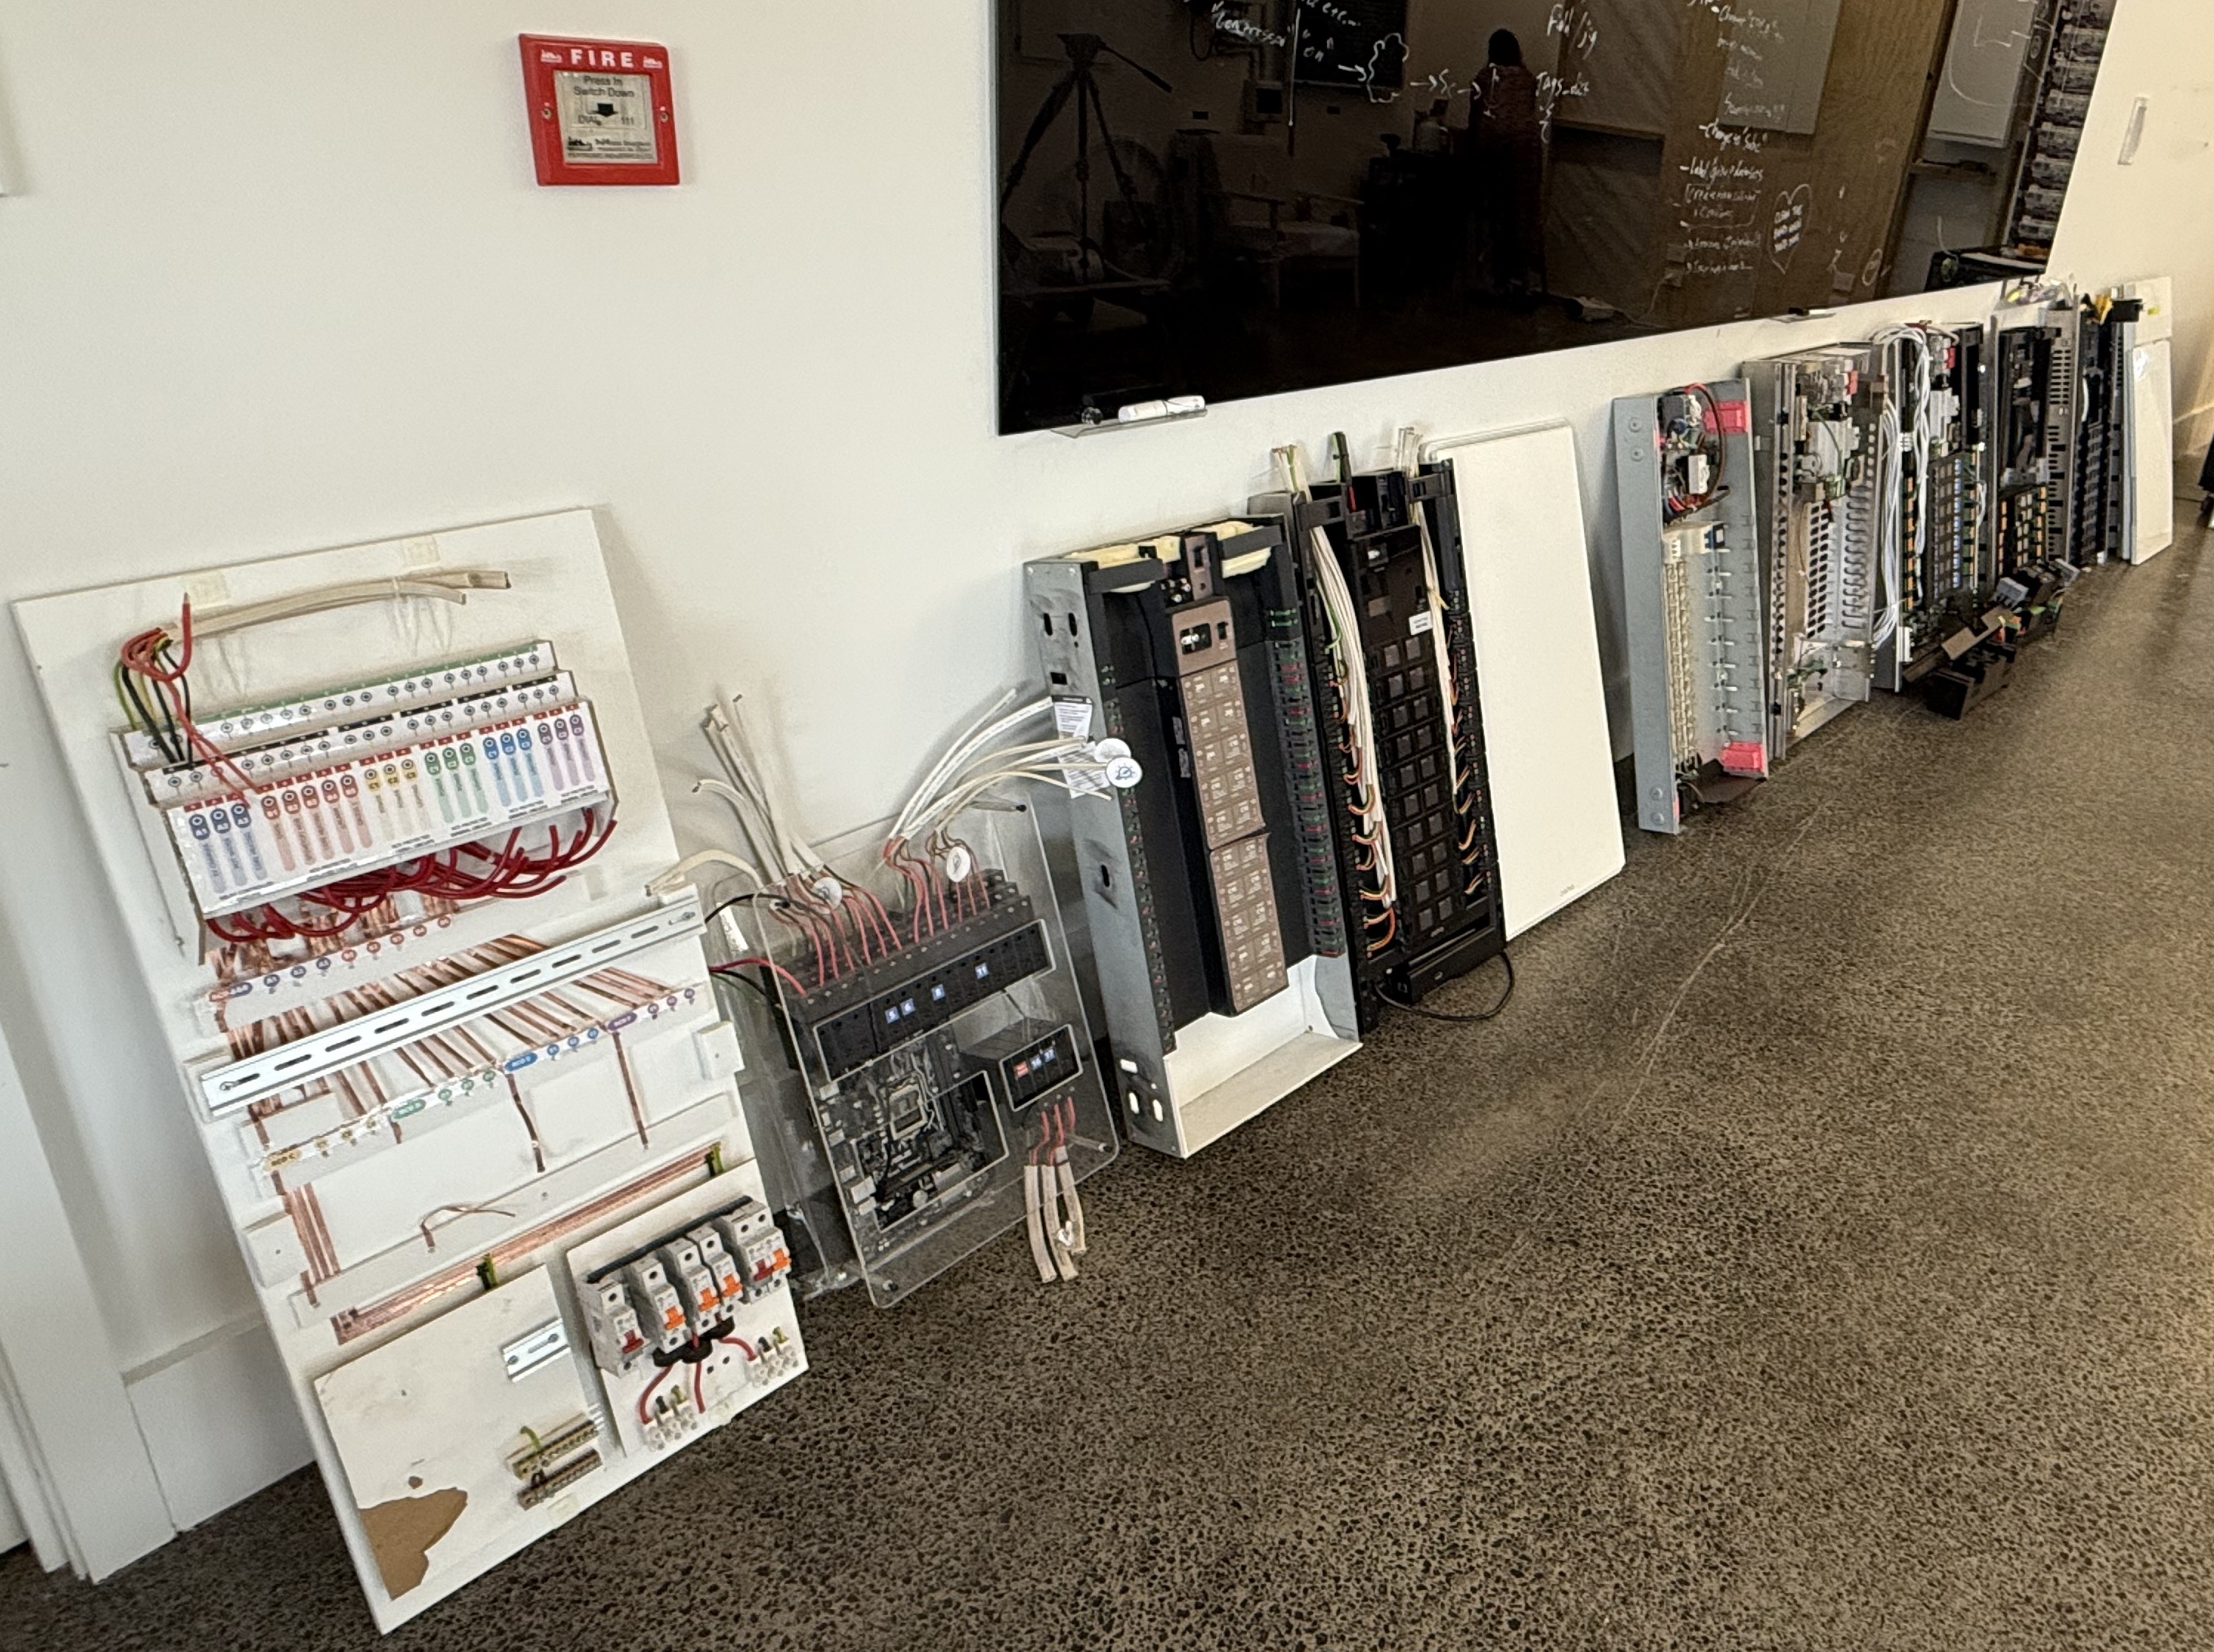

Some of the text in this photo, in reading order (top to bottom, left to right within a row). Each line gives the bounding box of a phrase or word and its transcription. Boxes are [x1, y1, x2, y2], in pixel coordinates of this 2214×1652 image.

[570, 48, 634, 68] FIRE
[583, 75, 611, 86] Press
[574, 86, 635, 98] Switch Down
